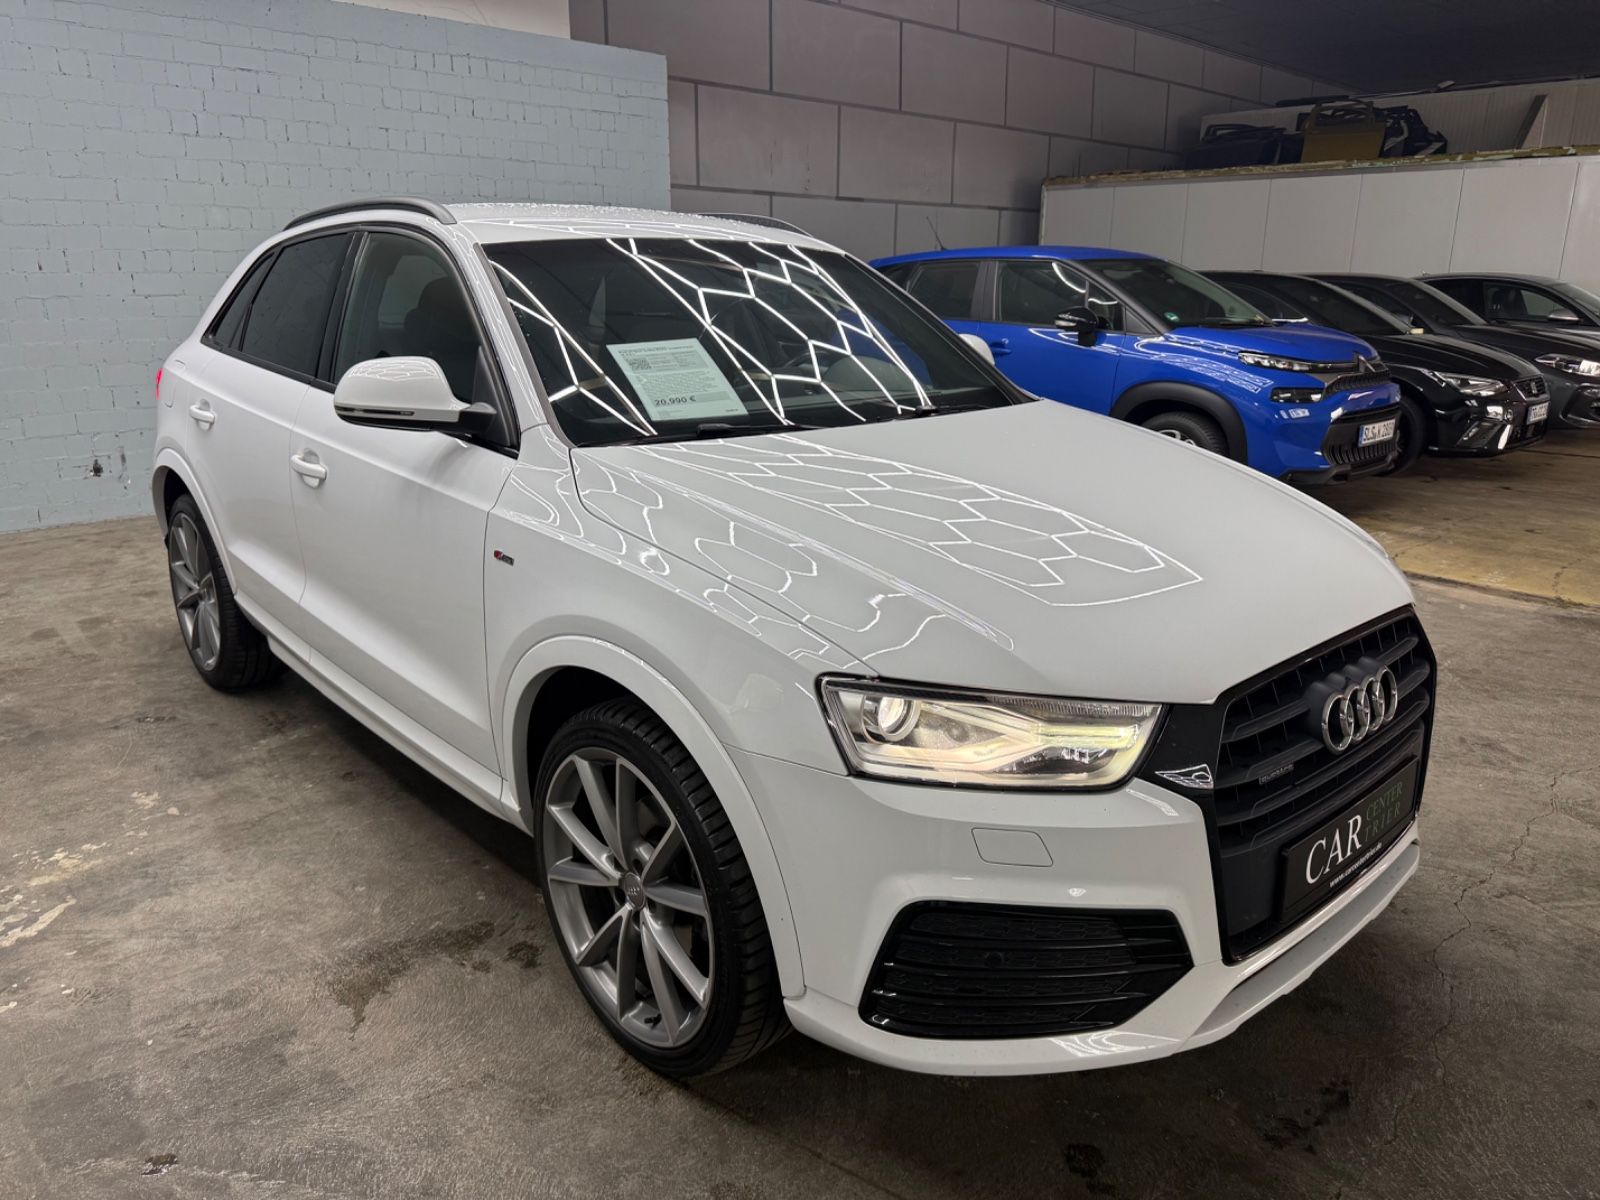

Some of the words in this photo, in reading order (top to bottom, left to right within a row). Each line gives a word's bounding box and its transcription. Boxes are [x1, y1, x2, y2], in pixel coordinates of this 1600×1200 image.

[654, 395, 688, 407] 20.990
[689, 394, 697, 403] €
[1366, 782, 1402, 821] CENTER
[1364, 802, 1400, 842] TRIER
[1305, 814, 1362, 884] CAR
